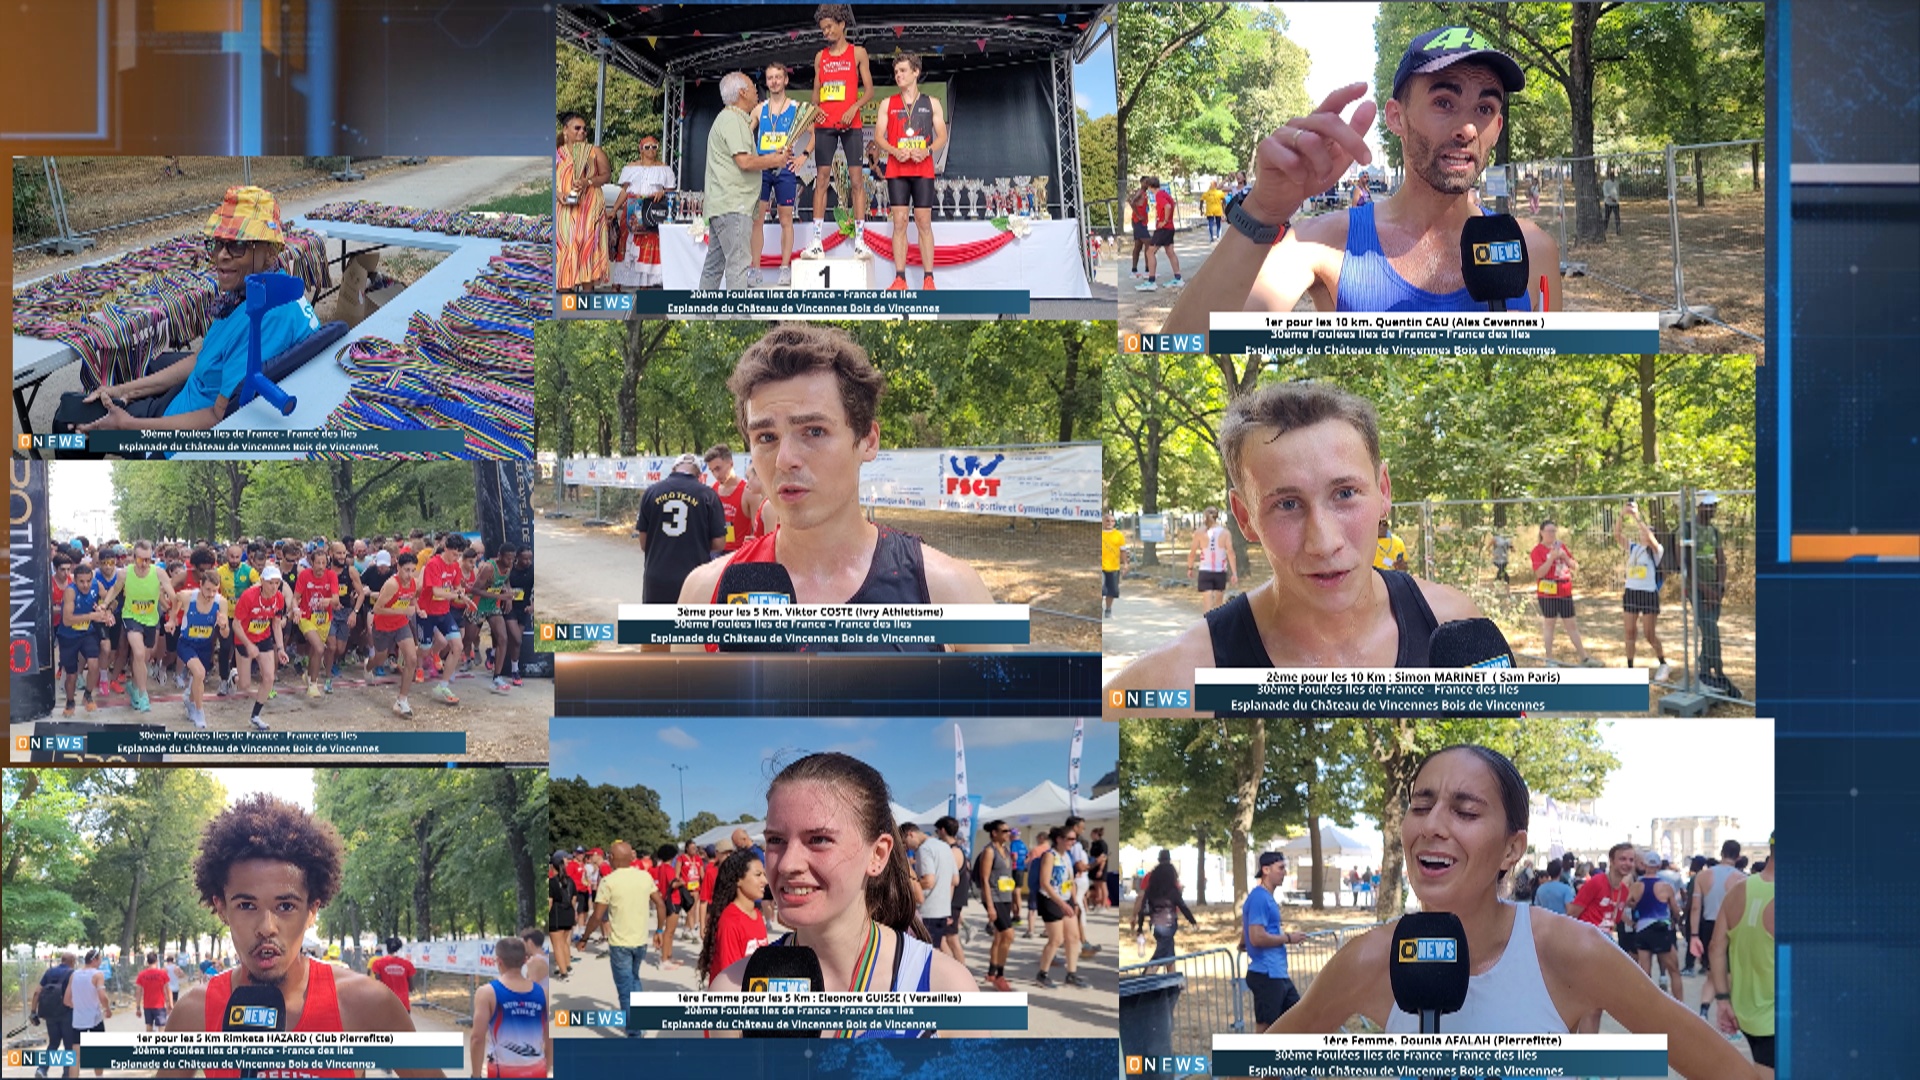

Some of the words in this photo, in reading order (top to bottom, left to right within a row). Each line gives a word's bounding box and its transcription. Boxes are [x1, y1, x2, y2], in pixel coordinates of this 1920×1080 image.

[1475, 243, 1520, 262] ONEWS
[818, 265, 831, 289] 1
[946, 477, 1001, 497] FSGT
[976, 501, 1006, 513] Sportive
[1008, 503, 1017, 512] et
[1018, 503, 1060, 516] Gymnique
[1062, 505, 1074, 516] du
[662, 500, 688, 537] 3
[1401, 941, 1455, 959] ONEWS
[231, 1007, 275, 1025] ONEWS
